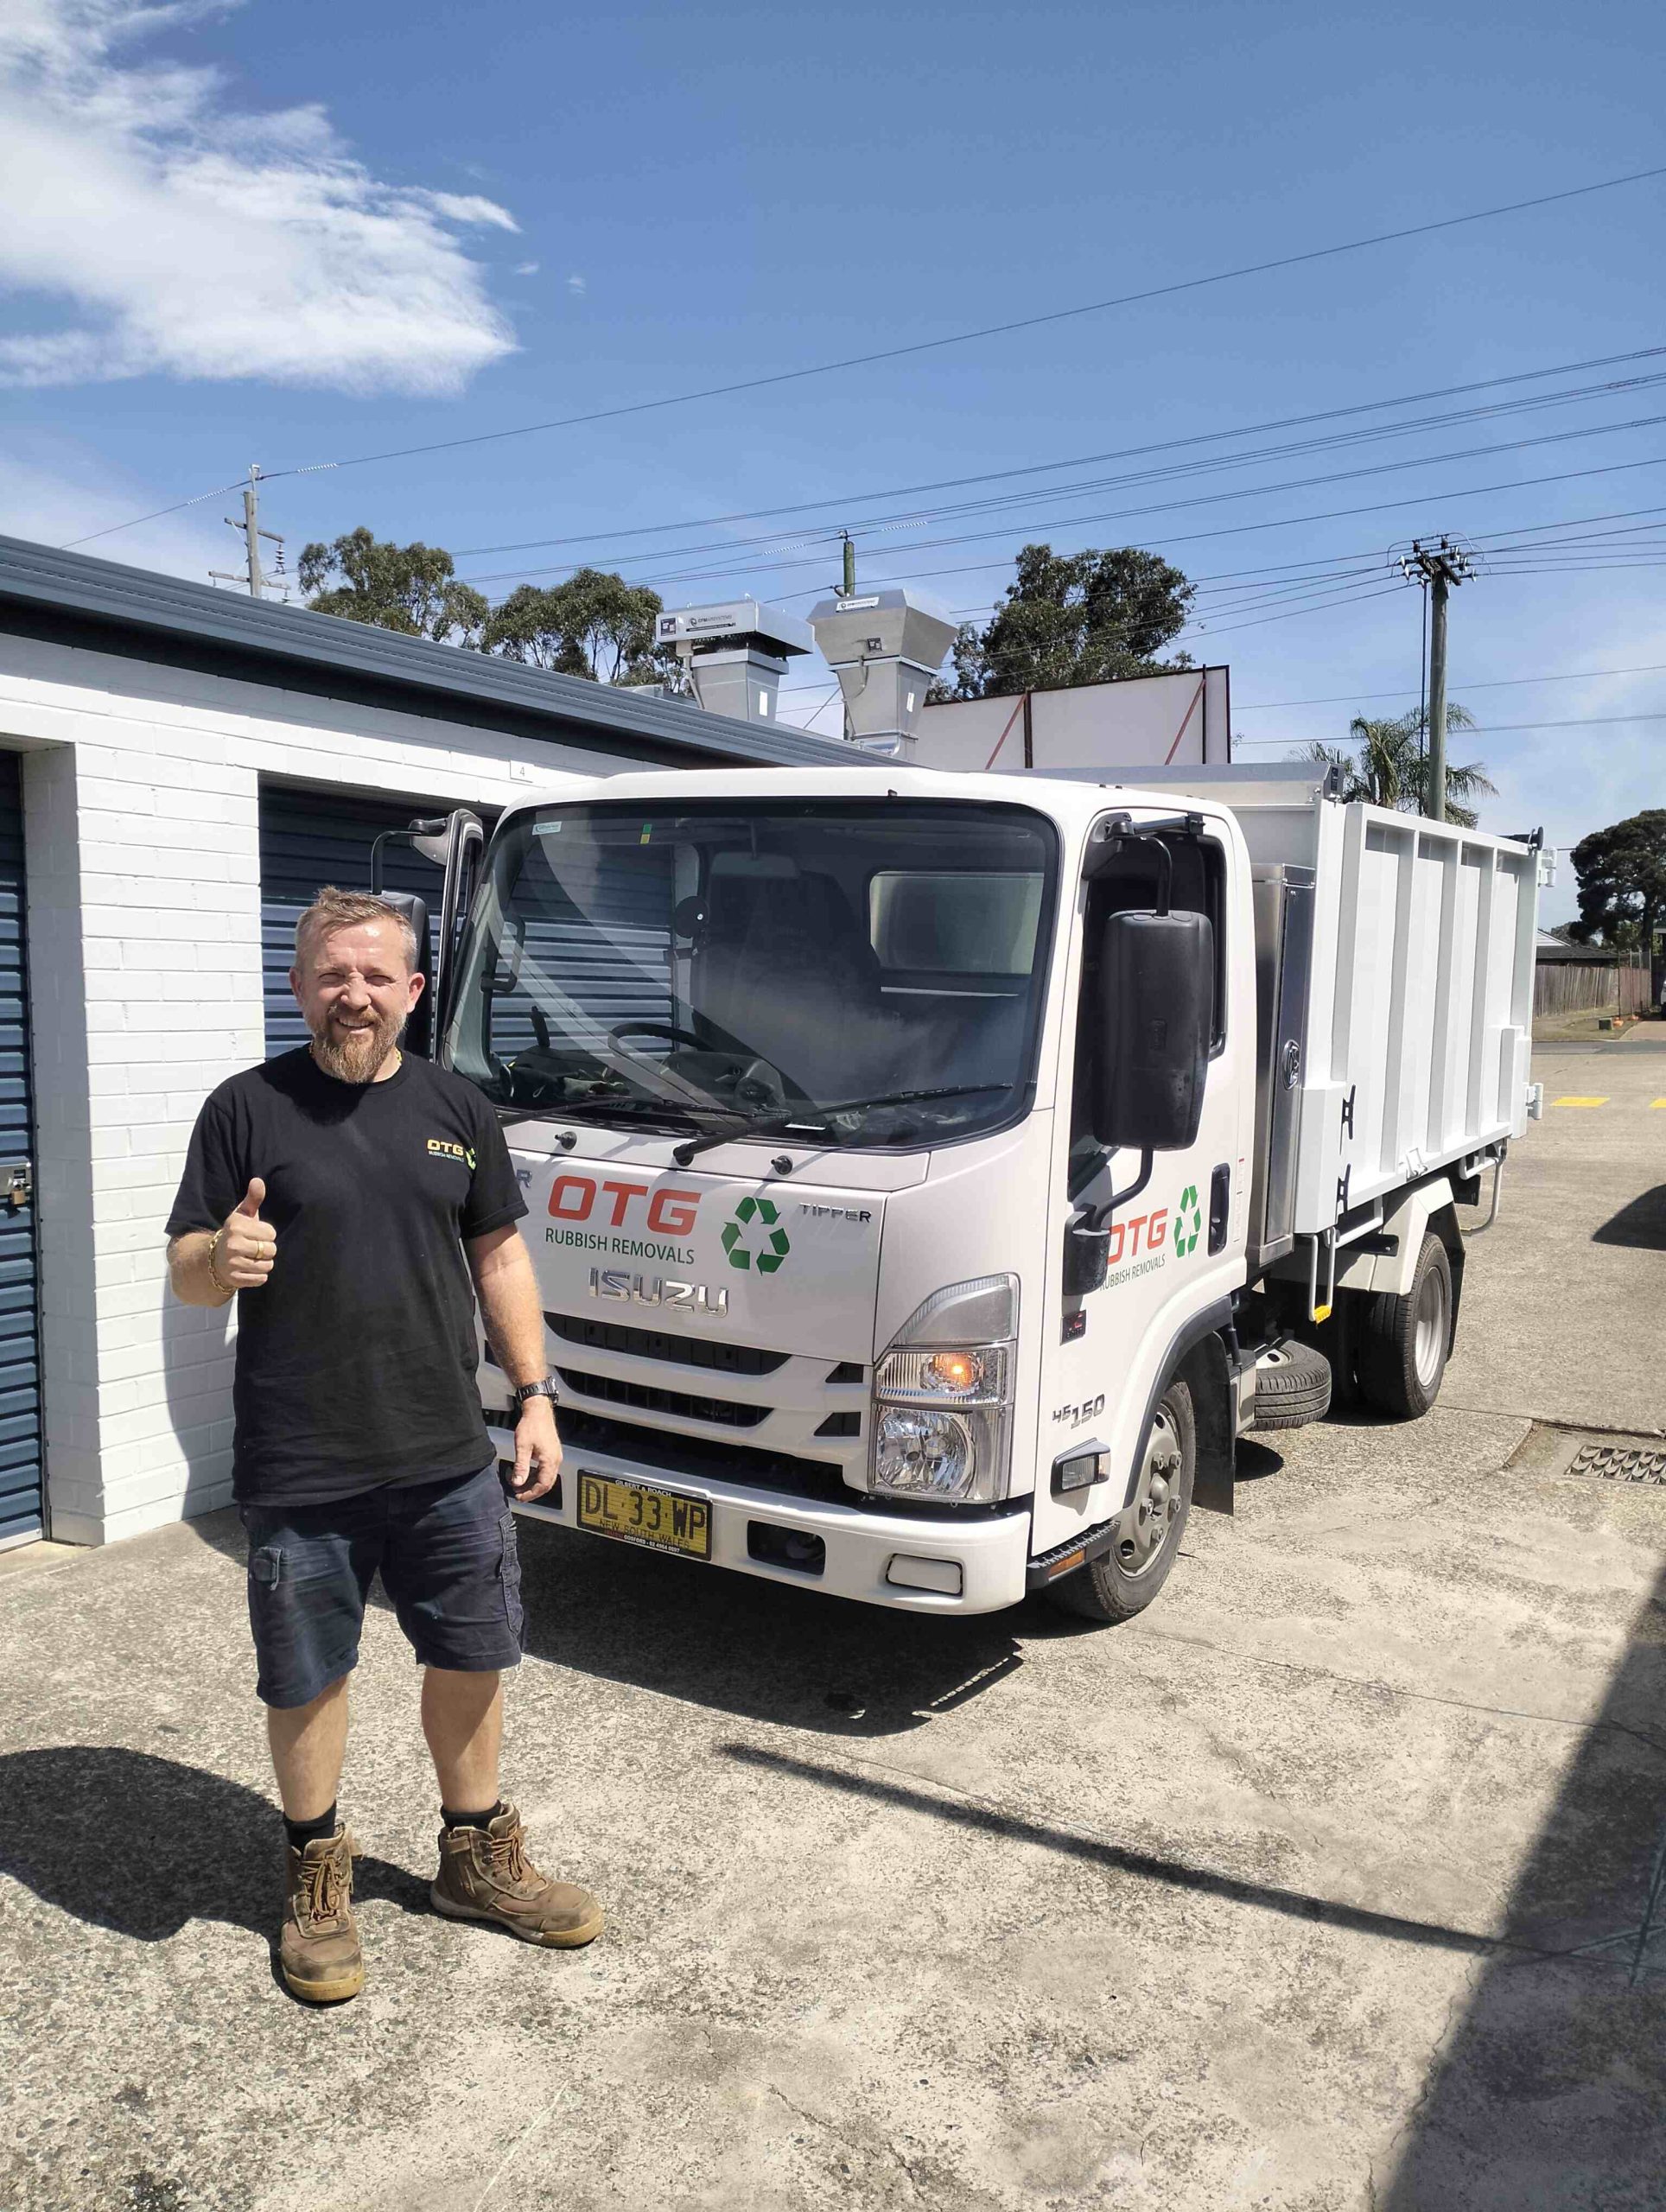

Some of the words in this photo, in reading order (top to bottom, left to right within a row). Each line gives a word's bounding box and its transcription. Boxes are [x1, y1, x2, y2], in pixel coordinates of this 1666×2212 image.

[519, 766, 525, 777] 4
[427, 1140, 464, 1156] OTG
[548, 1175, 702, 1236] OTG
[799, 1202, 872, 1224] TIPPER
[545, 1227, 607, 1252] RUBBISH
[612, 1237, 695, 1265] REMOVALS
[1107, 1208, 1168, 1266] OTG
[1132, 1253, 1166, 1280] REMOVALS
[588, 1267, 728, 1318] ISUZU
[647, 1487, 671, 1497] ROACH
[599, 1518, 620, 1529] NEW
[623, 1525, 654, 1540] SOUTH
[659, 1535, 690, 1548] WALES
